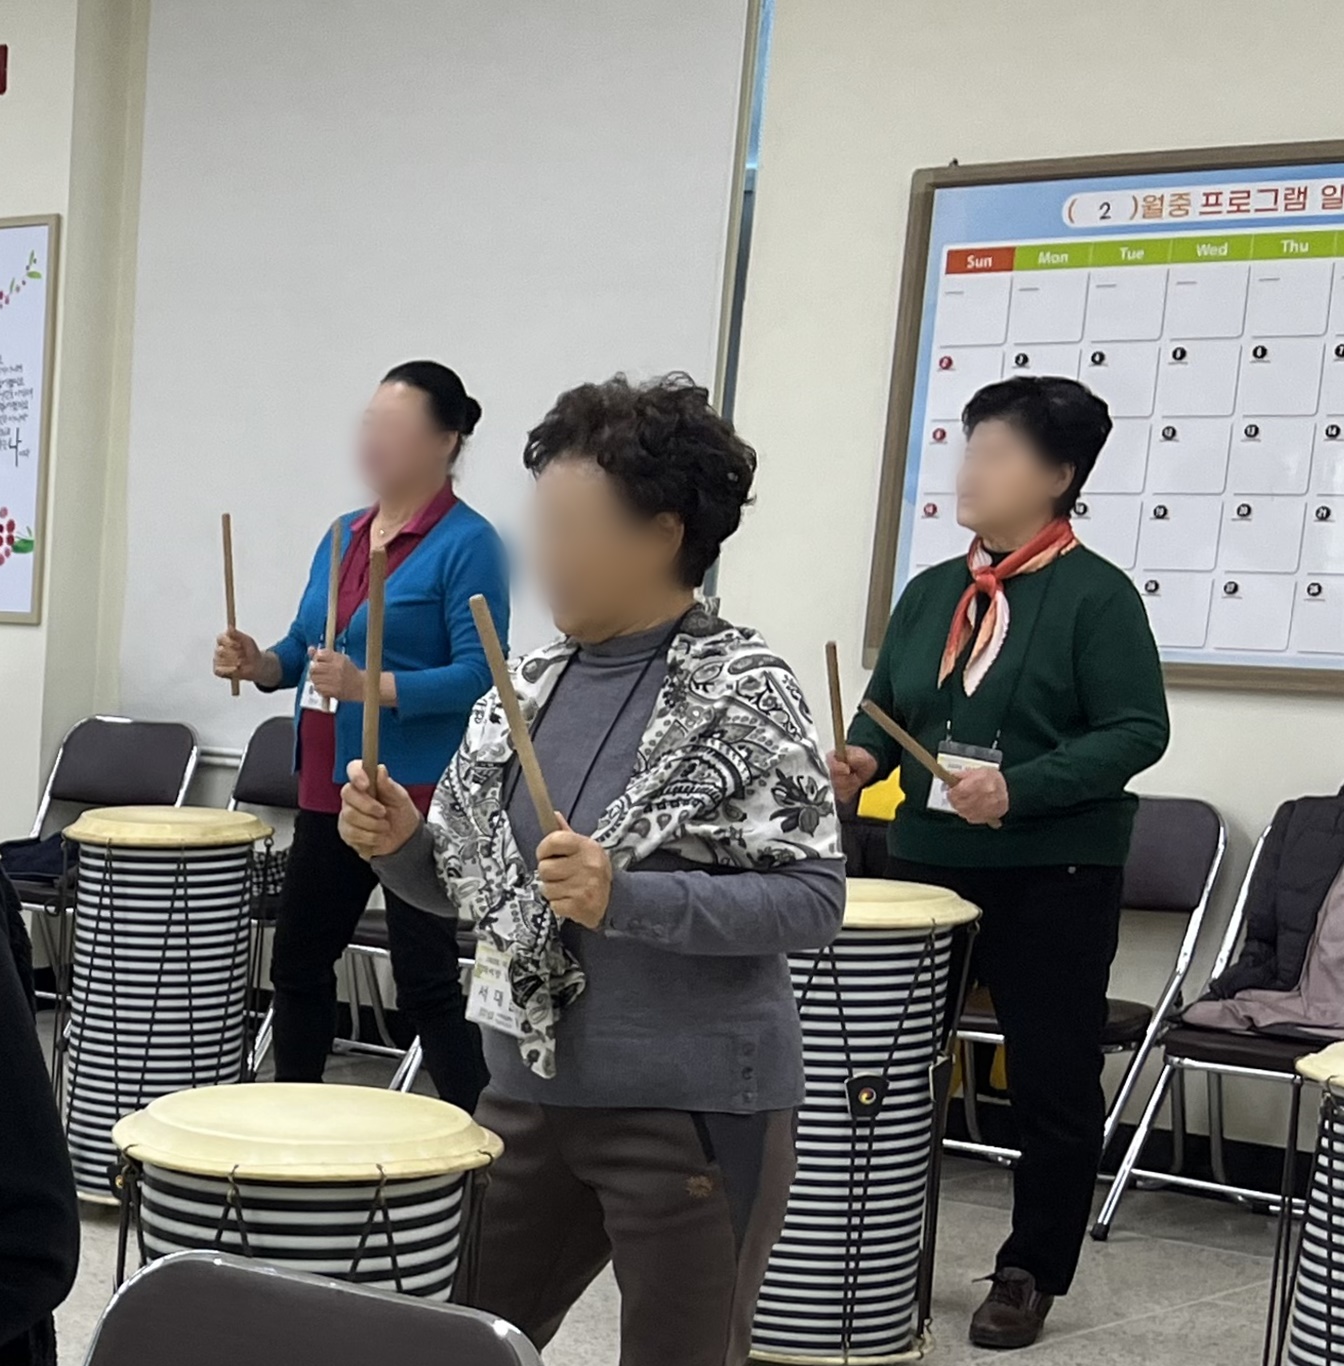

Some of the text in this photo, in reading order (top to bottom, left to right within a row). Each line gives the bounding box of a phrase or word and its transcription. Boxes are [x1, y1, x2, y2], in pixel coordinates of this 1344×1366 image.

[1098, 202, 1111, 220] 2
[1199, 186, 1308, 215] 프로그램
[967, 240, 1309, 268] Sun Mon Tue Wed Thu
